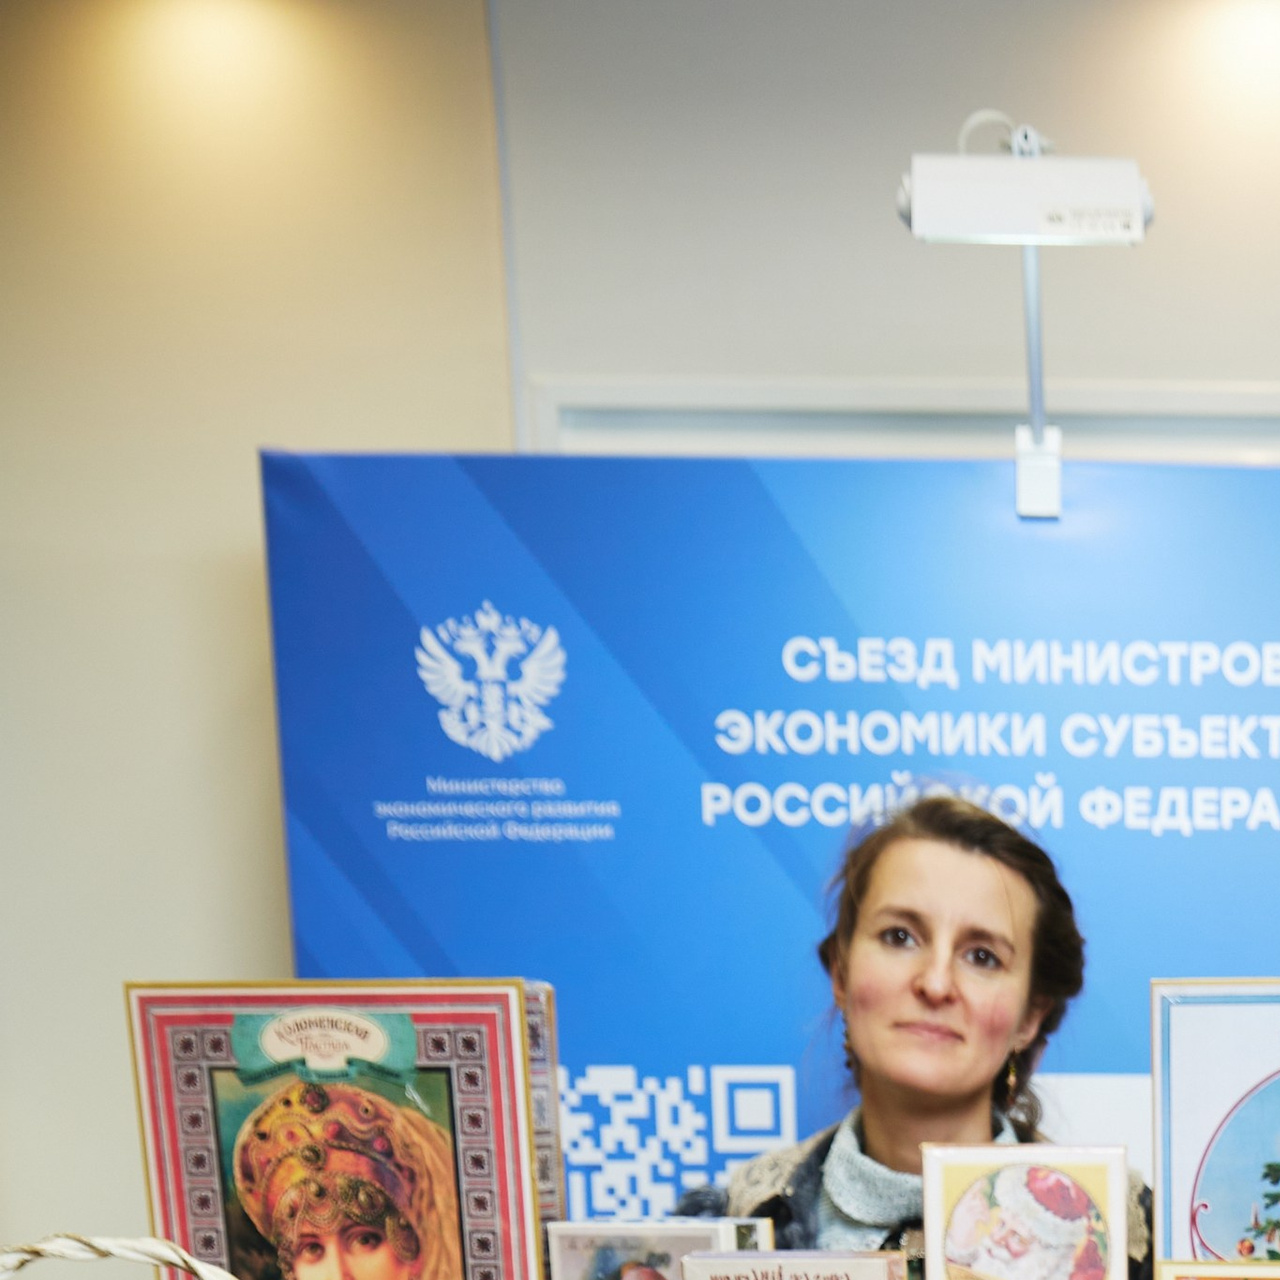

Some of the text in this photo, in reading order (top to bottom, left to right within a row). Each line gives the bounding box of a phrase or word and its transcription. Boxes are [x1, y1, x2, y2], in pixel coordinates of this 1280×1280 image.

[781, 636, 960, 690] СЪЕЗД
[713, 710, 1047, 757] ЭКОНОМИКИ
[426, 776, 566, 795] Министерство
[701, 771, 1064, 829] РОССИЙОЙ
[374, 800, 620, 818] экономического развития
[387, 820, 615, 841] Российской Федерации
